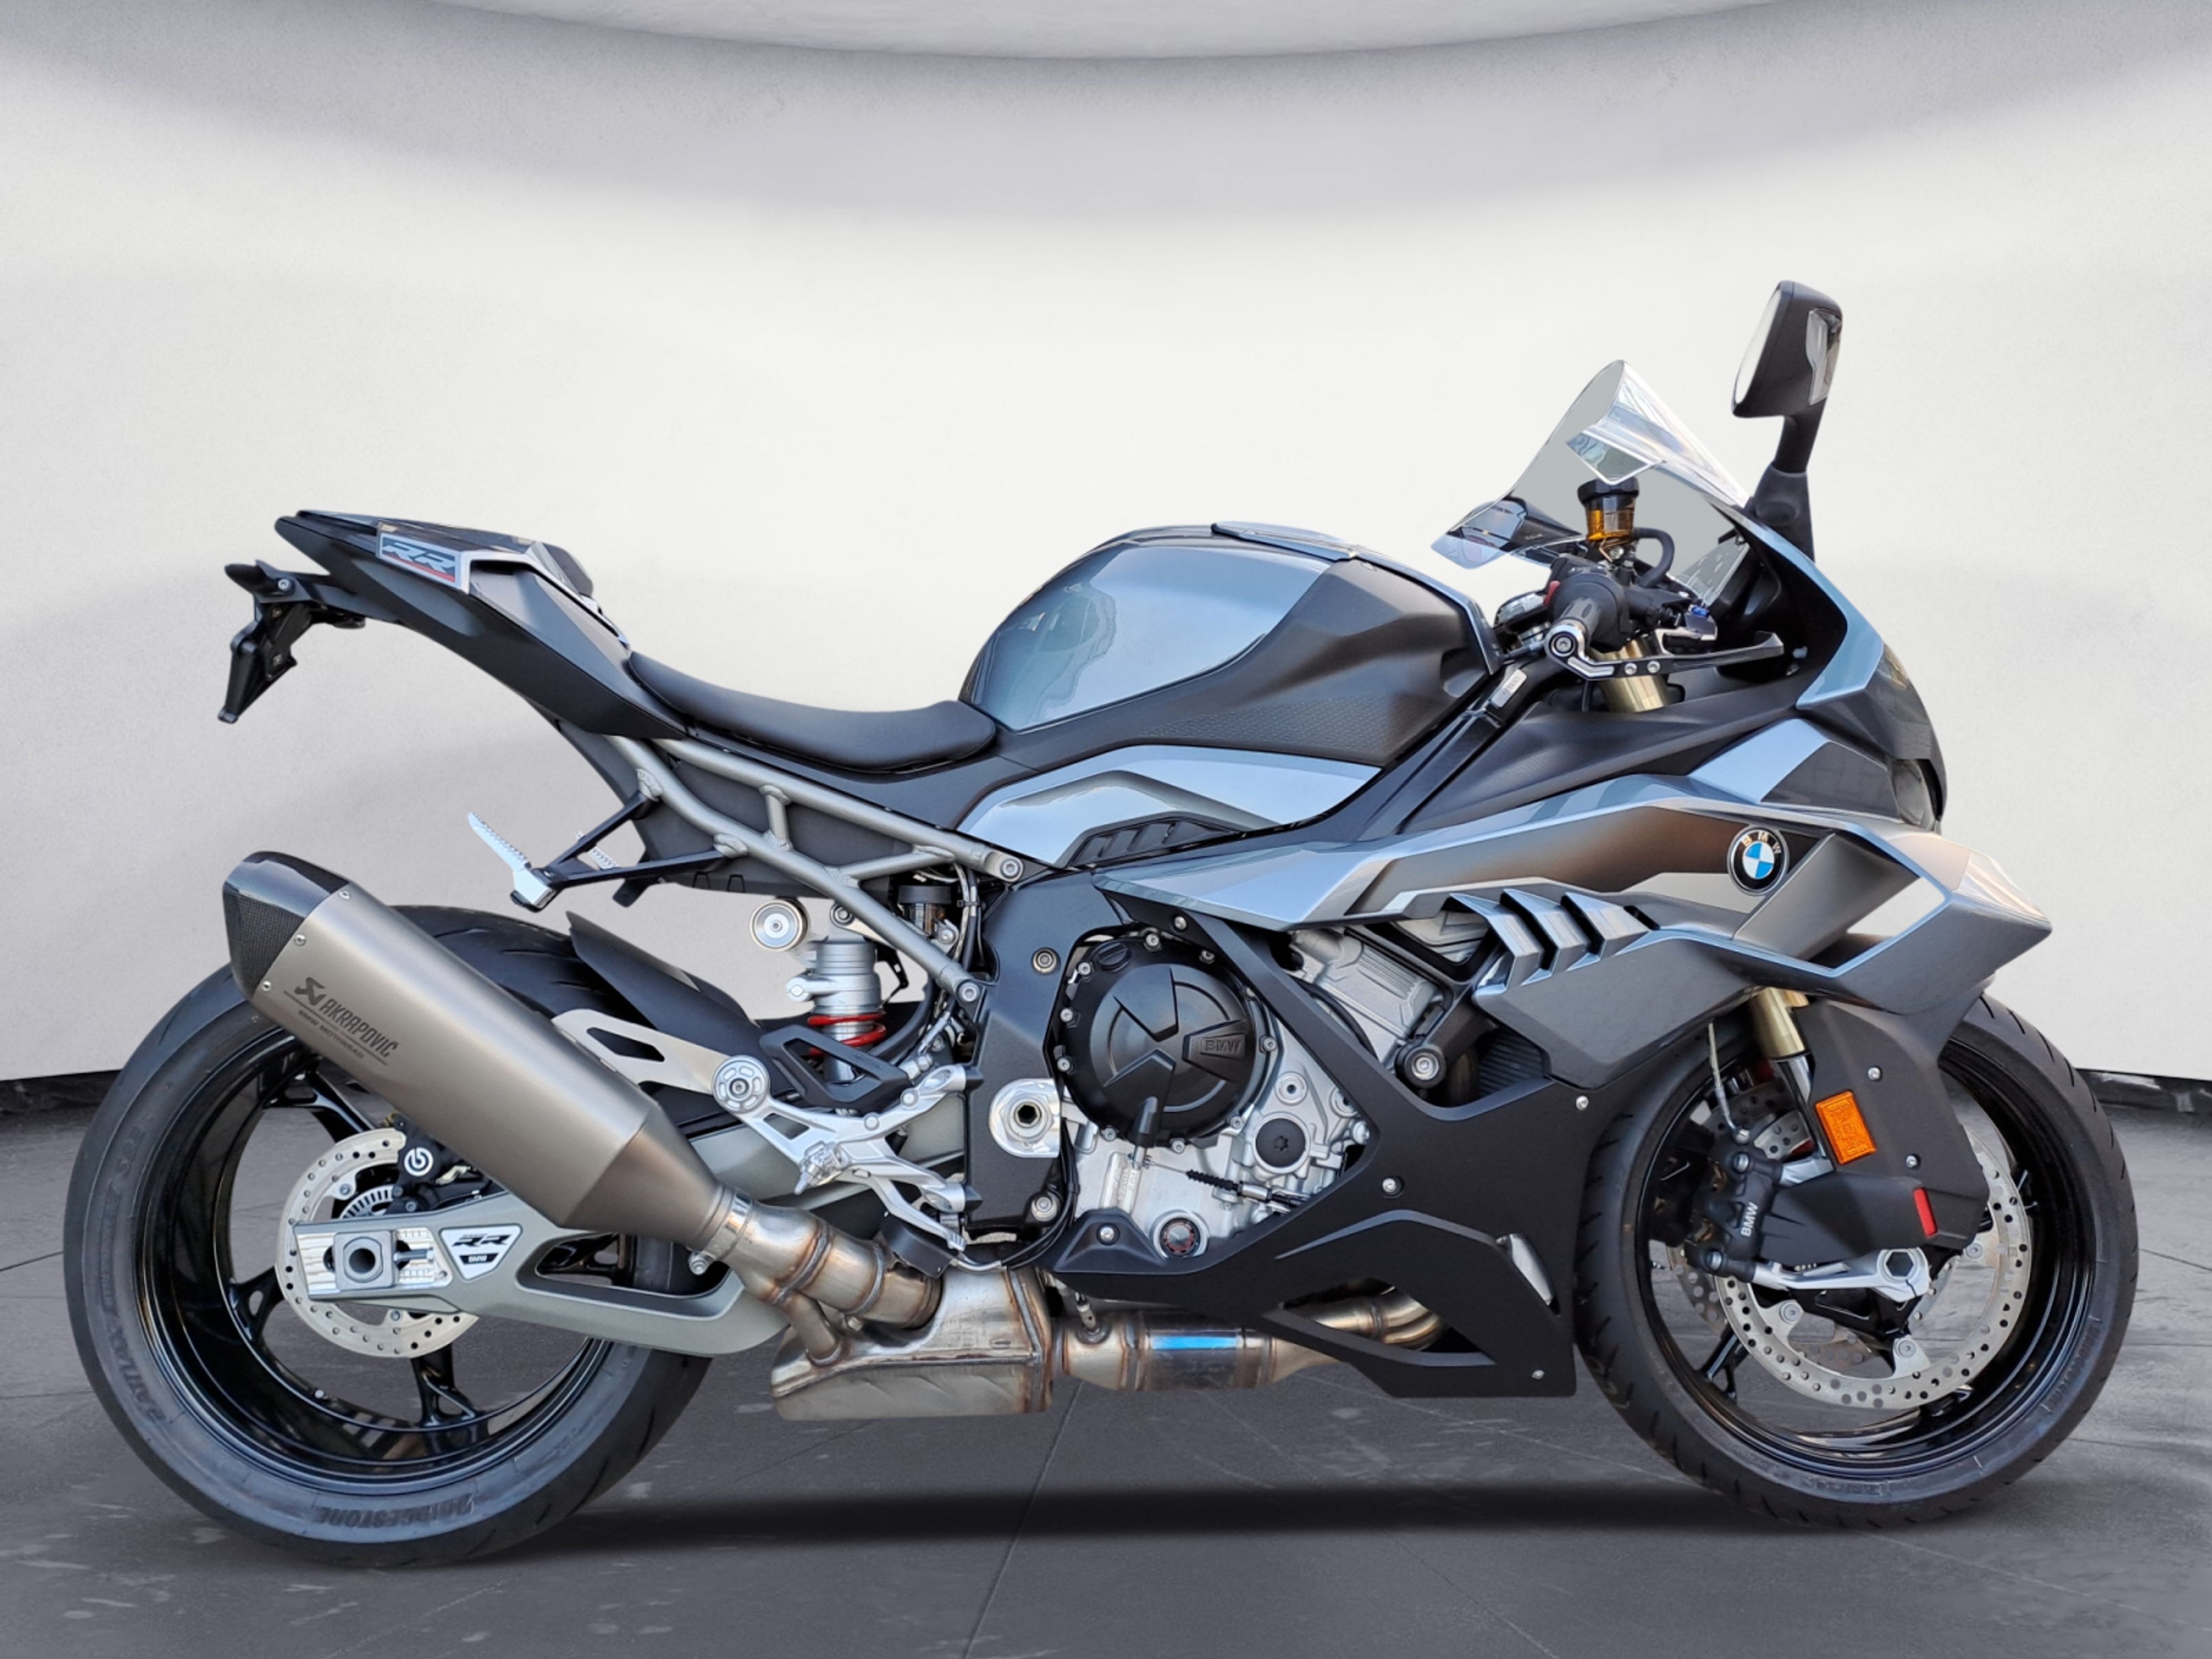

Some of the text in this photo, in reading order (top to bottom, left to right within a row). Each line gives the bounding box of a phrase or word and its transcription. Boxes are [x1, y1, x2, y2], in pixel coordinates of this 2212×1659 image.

[382, 541, 455, 574] RR
[1741, 831, 1782, 854] BMW
[1205, 1039, 1243, 1053] BMW
[1740, 1202, 1759, 1237] BMW
[451, 1234, 513, 1248] RR
[468, 1254, 488, 1263] BMW
